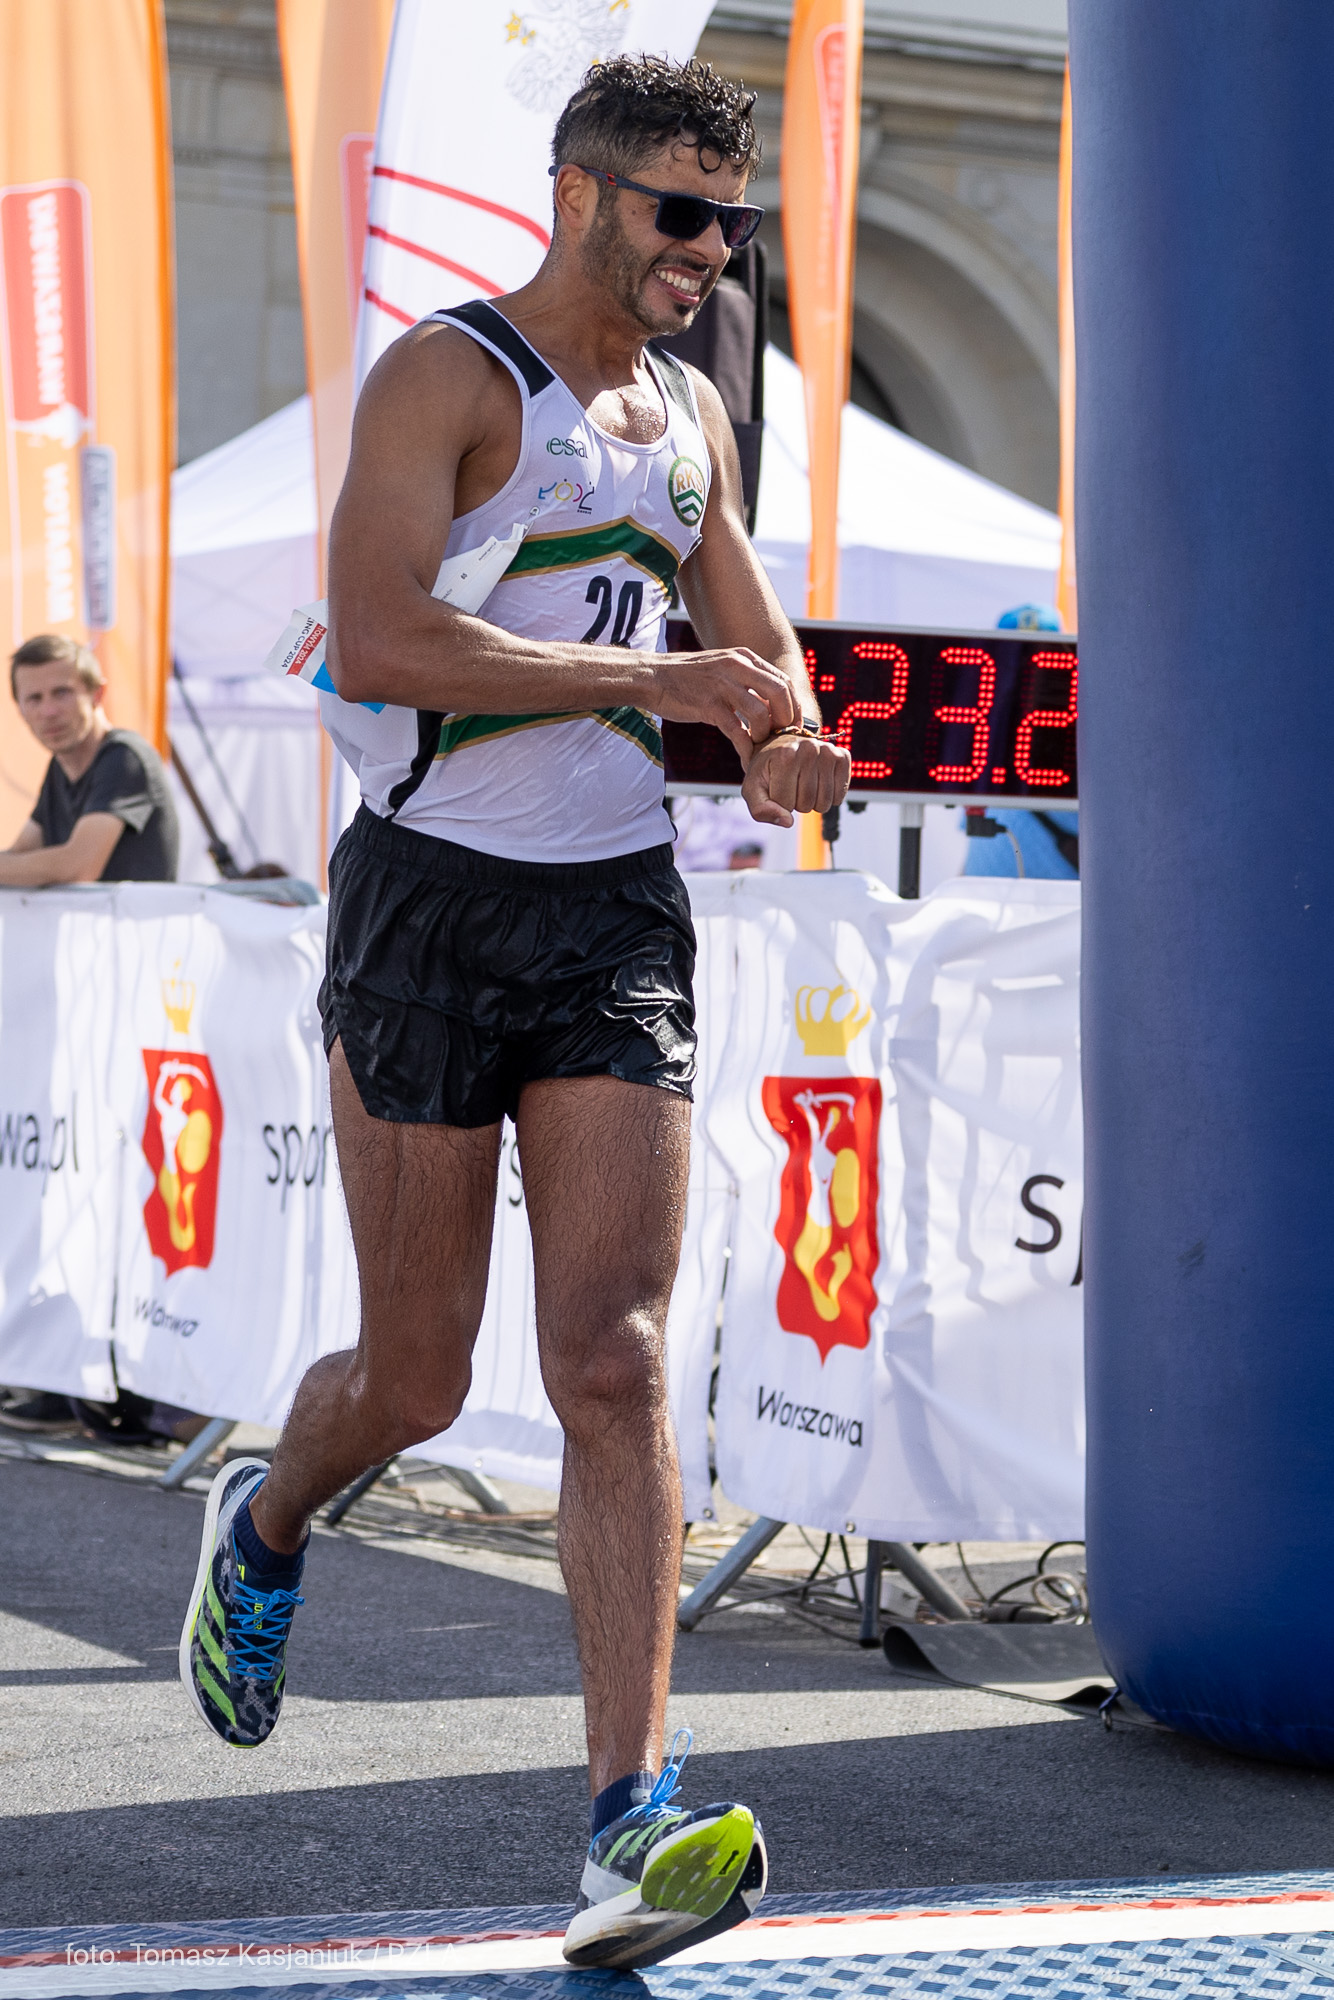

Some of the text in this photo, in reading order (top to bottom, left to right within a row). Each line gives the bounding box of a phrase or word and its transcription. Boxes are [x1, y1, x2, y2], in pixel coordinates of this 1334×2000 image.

[676, 466, 703, 494] RKS
[293, 635, 306, 651] CUP
[281, 651, 297, 668] 2024
[804, 641, 1079, 787] :23.2
[757, 1385, 863, 1448] Warszawa
